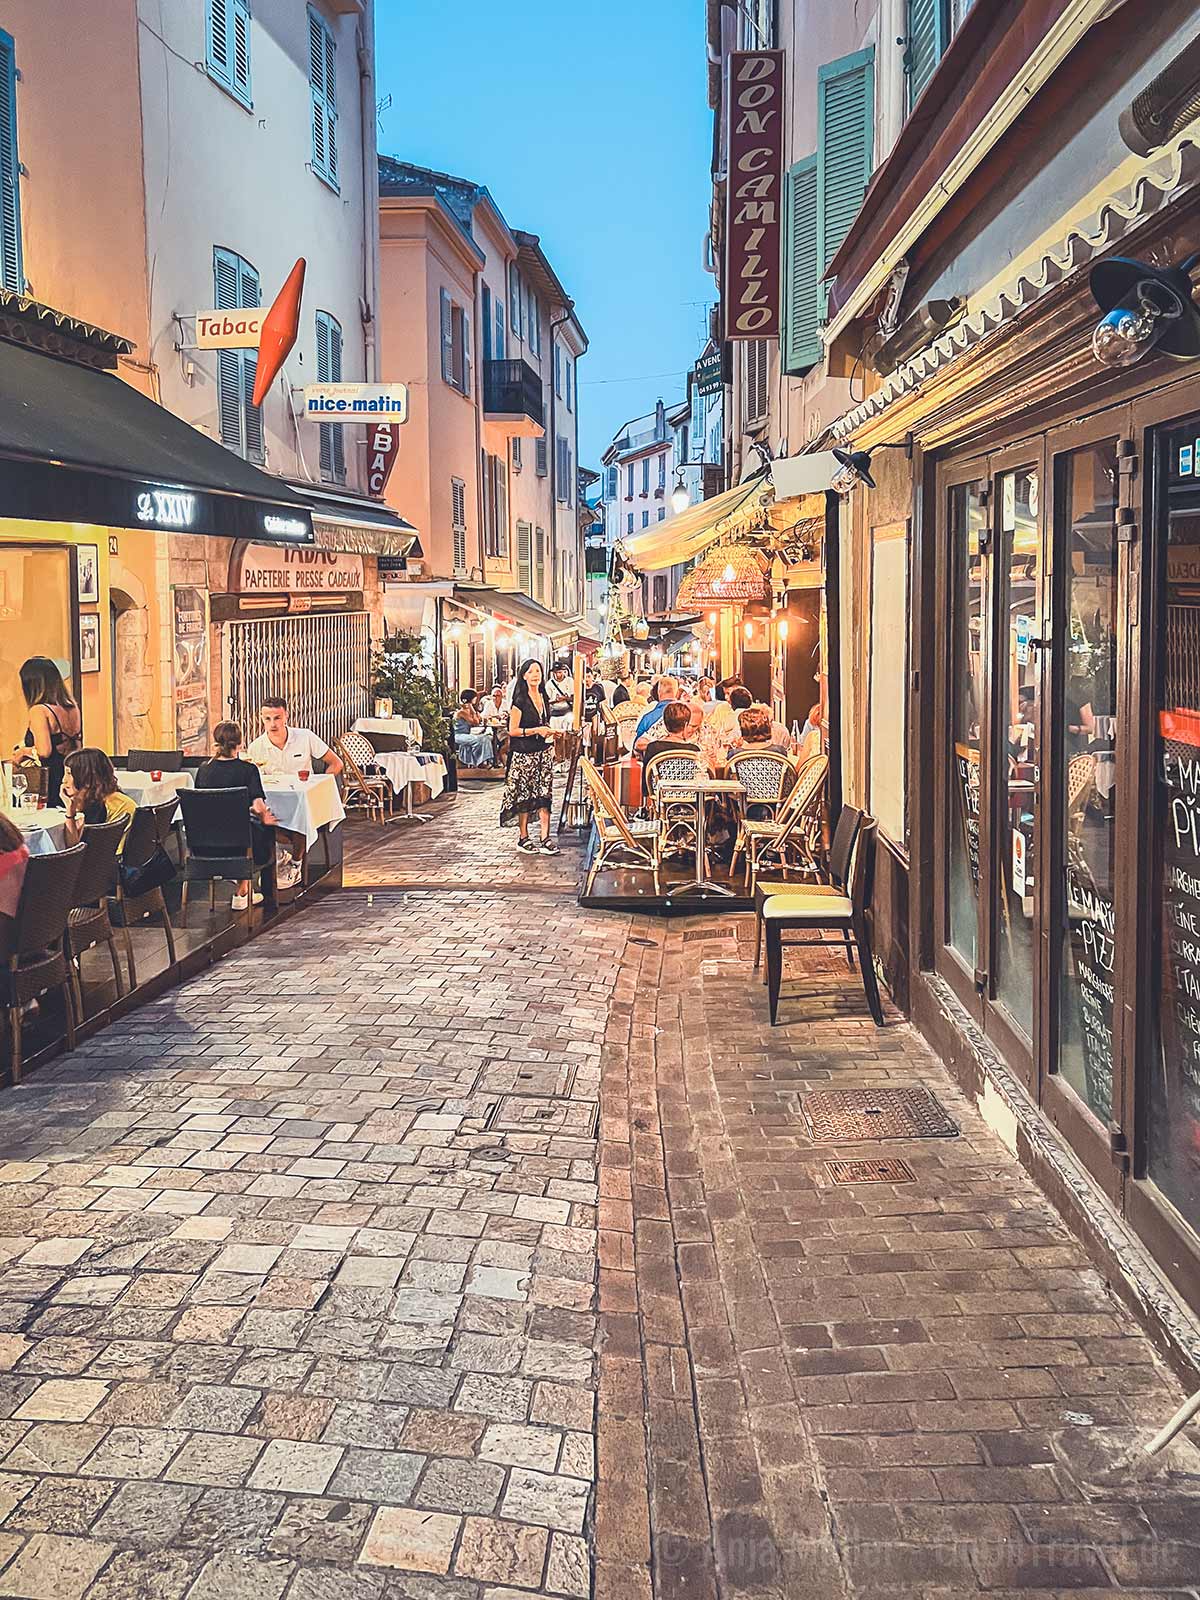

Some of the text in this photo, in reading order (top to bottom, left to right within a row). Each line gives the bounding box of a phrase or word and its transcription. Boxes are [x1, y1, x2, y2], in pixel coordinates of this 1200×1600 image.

[734, 57, 777, 332] DON CAMILLO
[198, 317, 260, 337] Tabac
[154, 491, 196, 526] XXIV
[245, 568, 361, 589] PAPETERIE PRESSE CADEAUX
